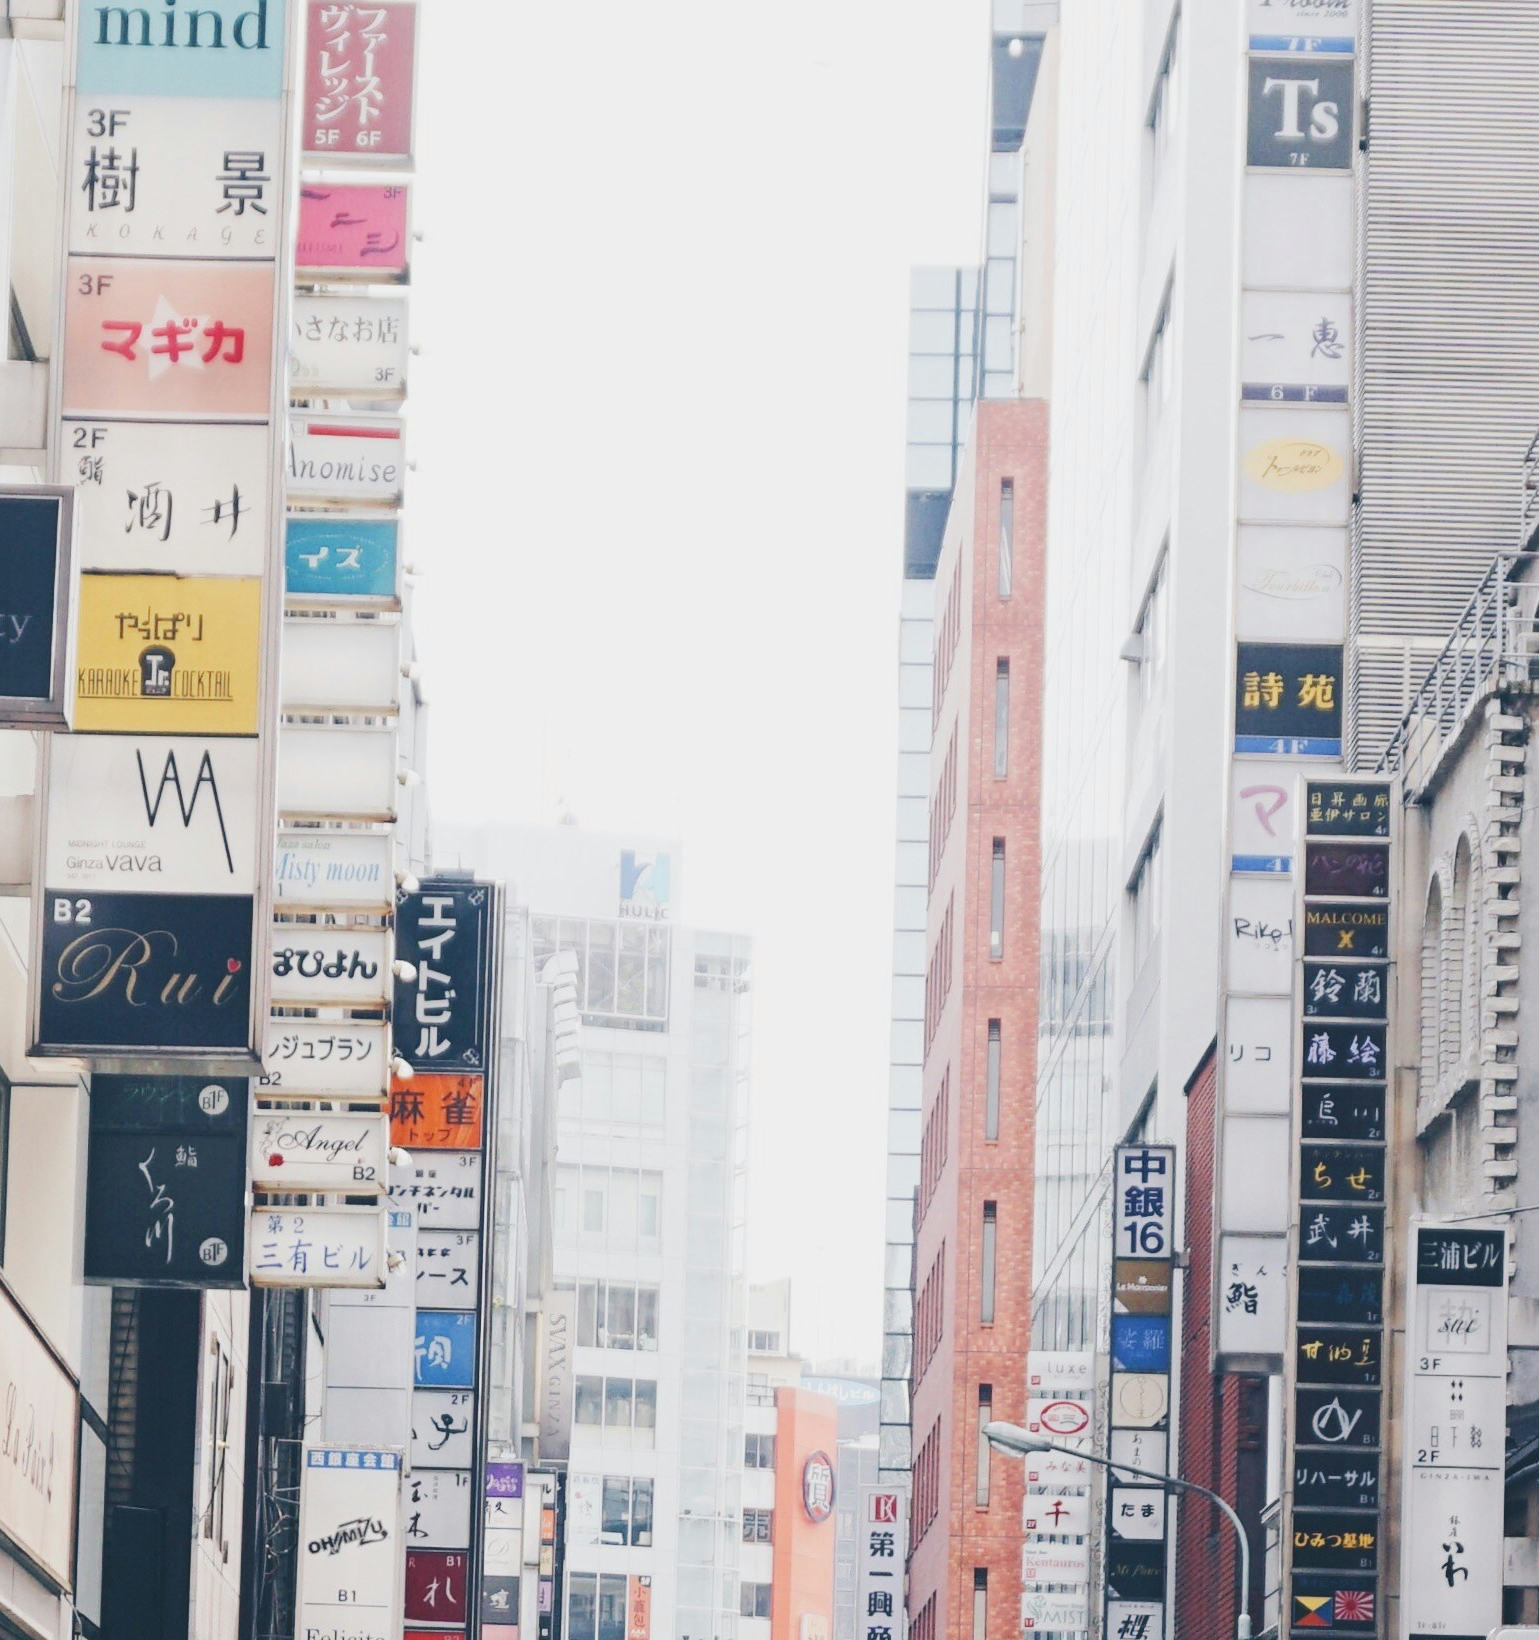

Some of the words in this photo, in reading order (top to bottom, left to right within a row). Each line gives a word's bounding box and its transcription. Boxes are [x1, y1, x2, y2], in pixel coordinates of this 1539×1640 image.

[94, 0, 270, 51] mind
[1283, 36, 1322, 51] 7F
[315, 4, 354, 122] ヴィレッジ
[351, 8, 388, 125] ファースト
[1262, 77, 1340, 140] Ts
[86, 109, 131, 138] 3F
[315, 129, 340, 145] 5F
[356, 130, 382, 146] 6F
[1290, 152, 1310, 166] 7F
[78, 273, 113, 297] 3F
[294, 315, 400, 344] さなお店
[100, 319, 246, 364] マギカ
[374, 367, 396, 382] 3F
[73, 428, 109, 449] 2F
[114, 606, 203, 641] やっぱり
[78, 667, 138, 696] KARAOKE
[174, 670, 233, 697] COCKTAIL
[1243, 671, 1336, 711] 詩苑
[1269, 738, 1309, 754] 4F
[66, 856, 103, 870] Ginza
[326, 859, 380, 882] moon
[53, 899, 92, 923] B2
[619, 904, 669, 918] HULIC
[1306, 911, 1386, 926] MALCOME
[1337, 930, 1355, 948] X
[52, 928, 242, 1006] Rui
[414, 896, 457, 1059] エイトビル
[1309, 968, 1381, 1004] 鈴蘭
[388, 1089, 477, 1126] 麻雀
[276, 1125, 367, 1163] Angel
[408, 1127, 452, 1143] トップ
[174, 1145, 198, 1168] 鮨
[459, 1156, 477, 1167] 3F
[352, 1166, 377, 1183] B2
[456, 1235, 475, 1246] 3F
[1306, 1213, 1374, 1249] 武井
[255, 1240, 373, 1274] 三有ビル
[1418, 1241, 1501, 1271] 三浦ビル
[1225, 1281, 1259, 1315] 鮨
[1047, 1362, 1087, 1374] luxe
[1419, 1357, 1441, 1371] 3F
[451, 1394, 469, 1405] 2F
[1418, 1450, 1440, 1463] 2F
[455, 1473, 469, 1487] 1F
[1296, 1468, 1376, 1487] リハーサル
[1045, 1500, 1070, 1528] 千
[1120, 1502, 1155, 1518] たま
[1294, 1531, 1375, 1550] ひみつ基地
[446, 1555, 461, 1567] B1
[338, 1589, 357, 1602] B1
[1043, 1611, 1084, 1625] MIST
